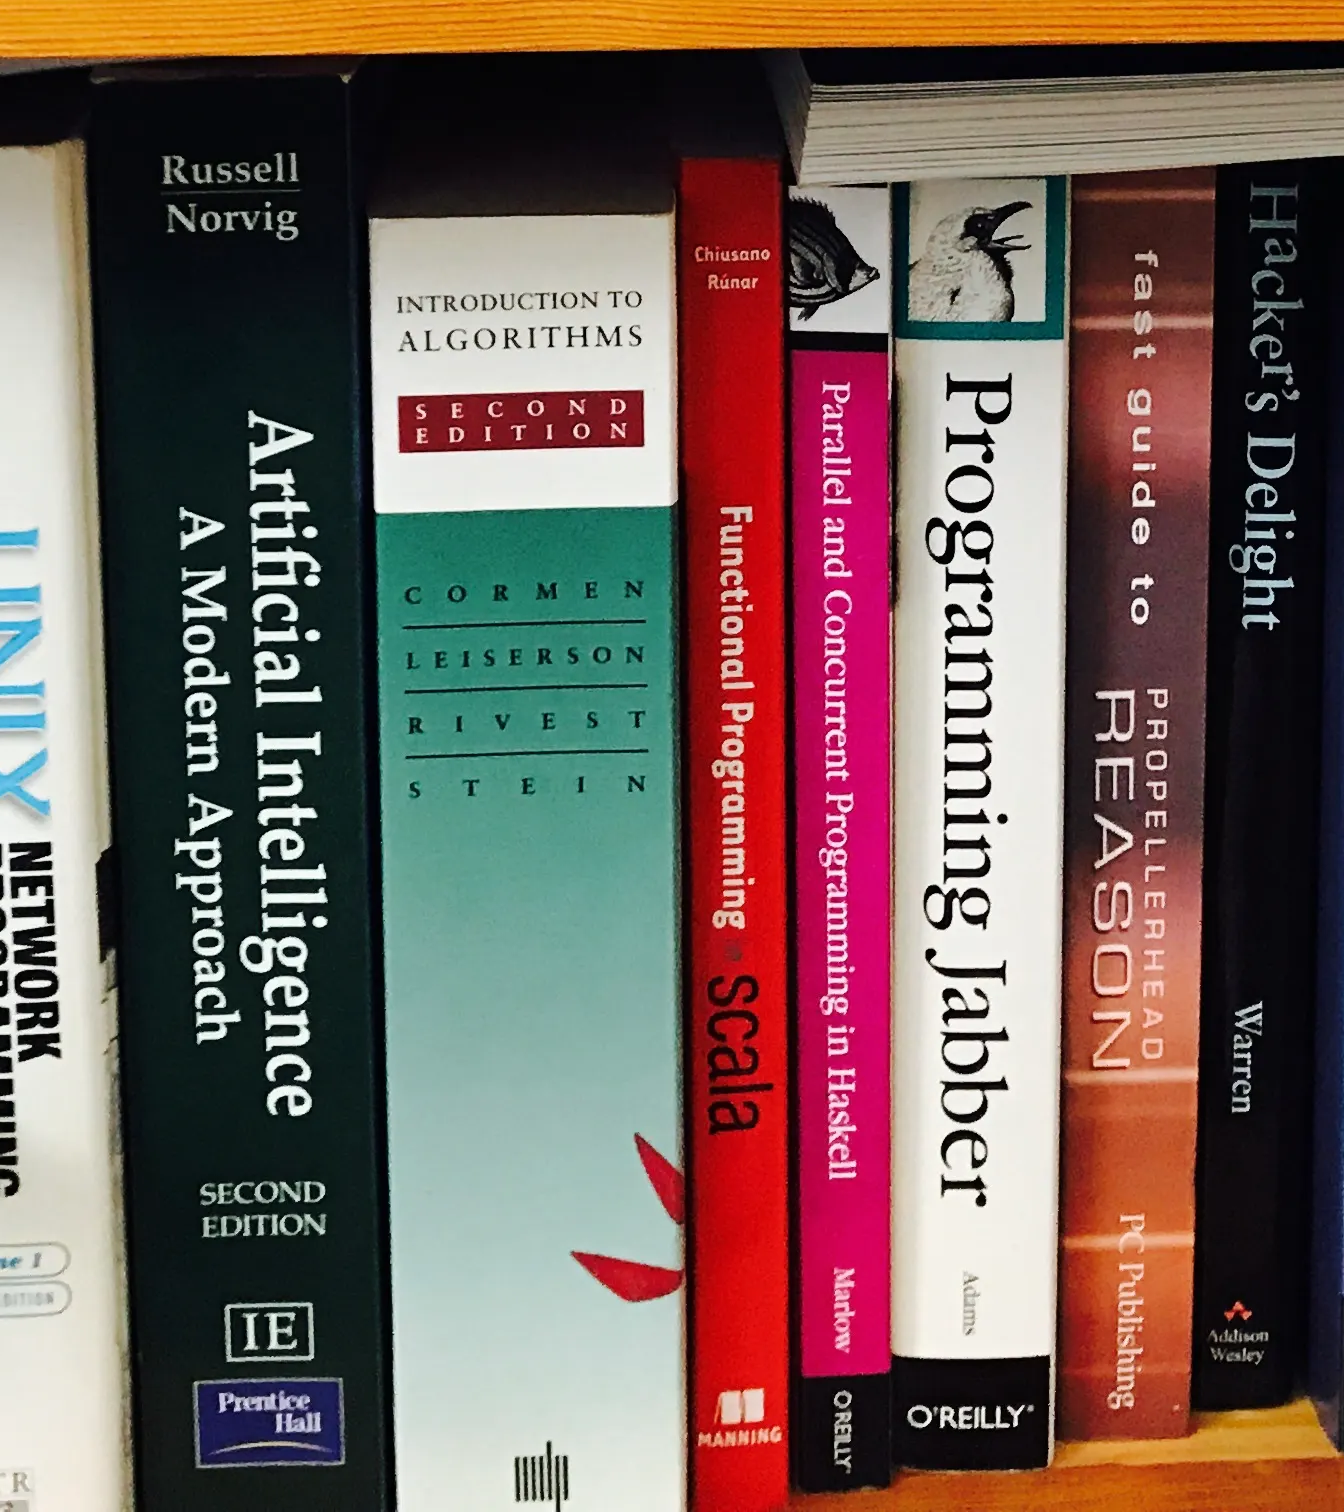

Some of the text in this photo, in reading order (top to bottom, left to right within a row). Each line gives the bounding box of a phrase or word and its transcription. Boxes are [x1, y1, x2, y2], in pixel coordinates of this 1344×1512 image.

[161, 154, 299, 185] Russell
[166, 203, 298, 242] Norvig
[694, 245, 771, 264] Chiusano
[397, 290, 643, 314] INTRODUCTION TO
[707, 274, 759, 290] Rúnar
[398, 325, 643, 353] ALGORITHMS
[1229, 181, 1304, 632] Hacker's Delight
[404, 581, 645, 605] CORMEN
[719, 505, 753, 692] Functional
[407, 646, 644, 669] LEISERSON
[240, 409, 329, 1117] Artificial Intelligence
[818, 381, 856, 1180] Parallel and Concurrent Programming in Haskell
[711, 700, 756, 931] Programming
[1092, 688, 1135, 1070] REASON
[1140, 688, 1169, 1062] PROPELLERHEAD
[8, 842, 62, 1061] NETWORK
[834, 1267, 856, 1354] Marlow
